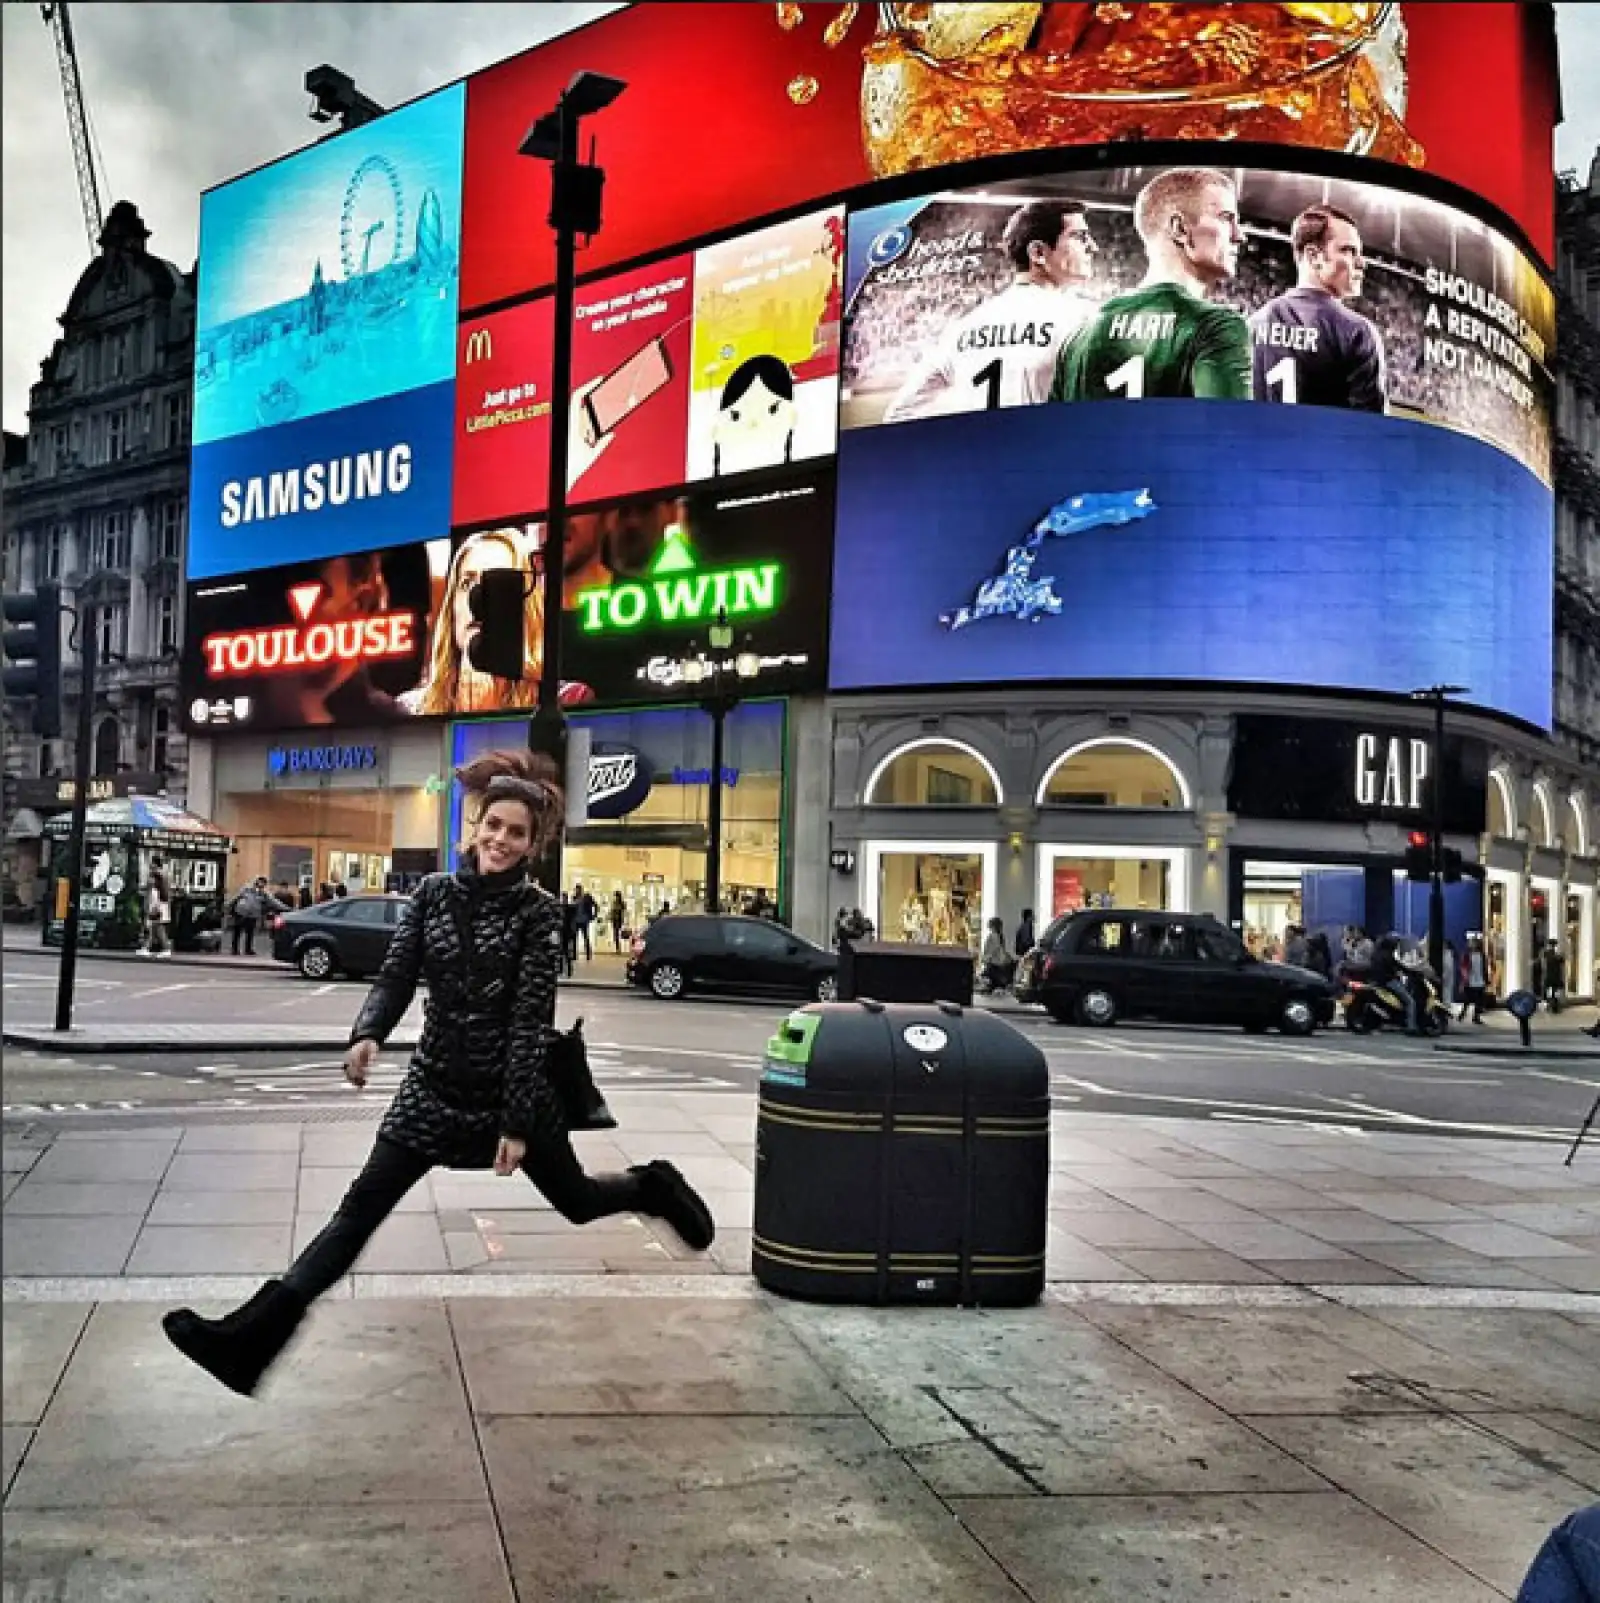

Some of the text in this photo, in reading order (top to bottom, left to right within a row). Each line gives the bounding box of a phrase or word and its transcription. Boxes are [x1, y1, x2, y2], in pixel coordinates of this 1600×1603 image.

[1425, 266, 1517, 336] SHOULDERS
[1425, 303, 1440, 329] A
[1108, 312, 1177, 340] HART
[1255, 322, 1320, 352] NEUER
[1105, 355, 1145, 399] 1
[1424, 337, 1468, 372] NOT
[972, 357, 1003, 410] 1
[1265, 357, 1297, 405] 1
[221, 443, 412, 528] SAMSUNG
[576, 565, 780, 630] TO WIN
[205, 613, 414, 674] TOULOUSE
[289, 745, 378, 772] BARCLAYS
[1355, 733, 1428, 809] GAP
